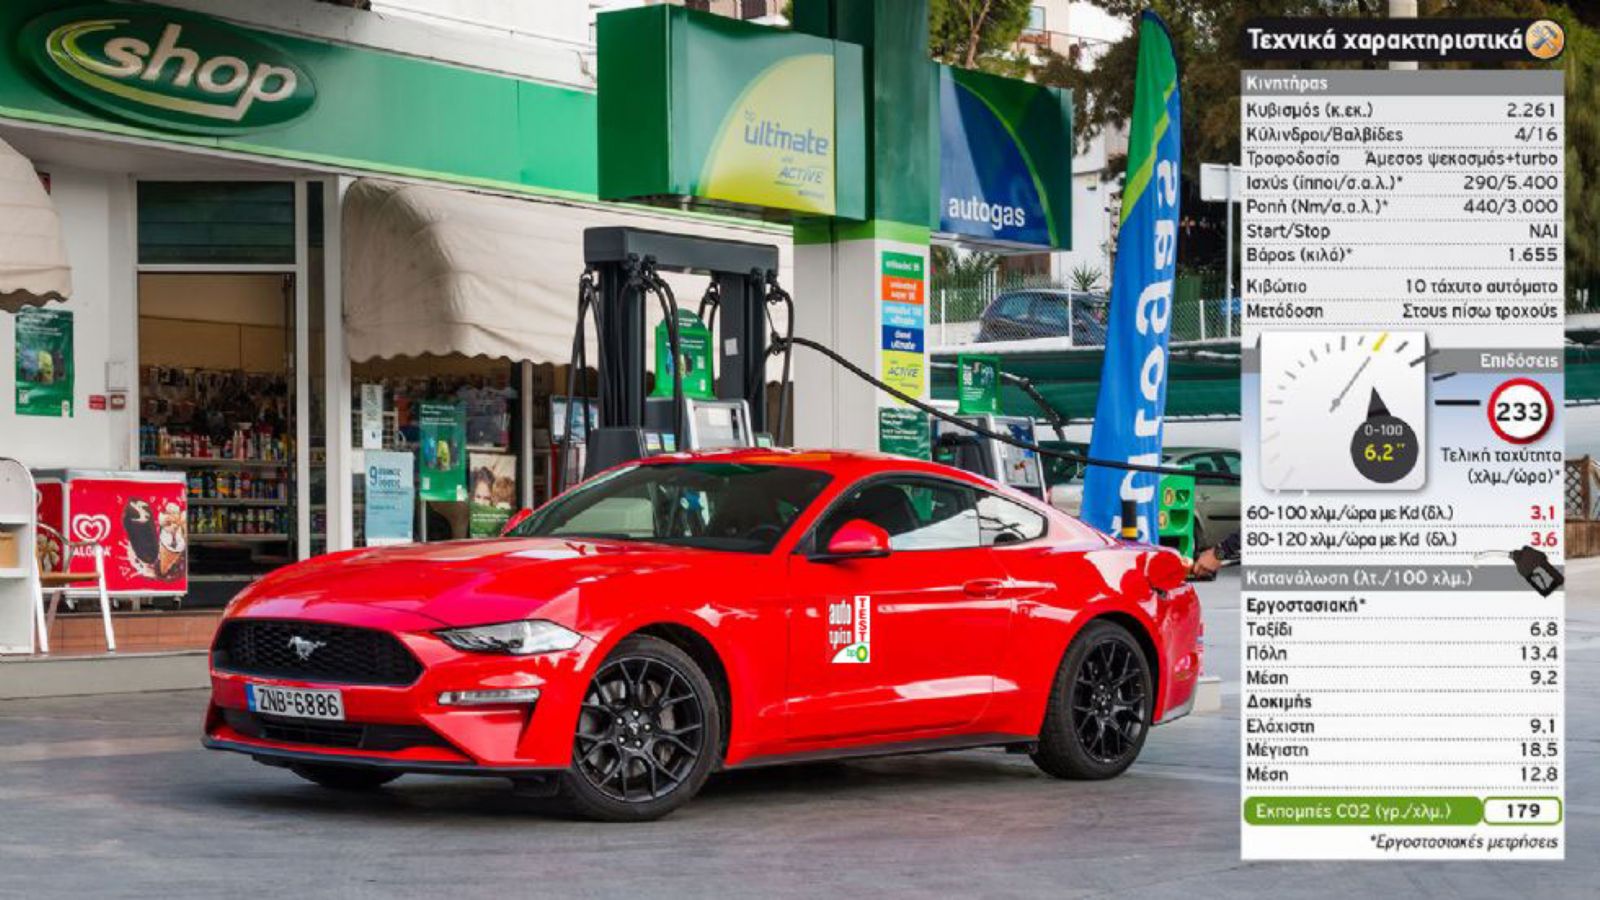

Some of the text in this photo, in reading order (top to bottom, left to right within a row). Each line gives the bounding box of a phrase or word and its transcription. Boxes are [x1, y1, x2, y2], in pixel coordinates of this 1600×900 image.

[103, 24, 297, 121] shop
[744, 120, 828, 155] ultimate
[779, 167, 824, 183] ACTIVE
[948, 196, 1025, 230] autogas
[859, 597, 867, 642] TEST
